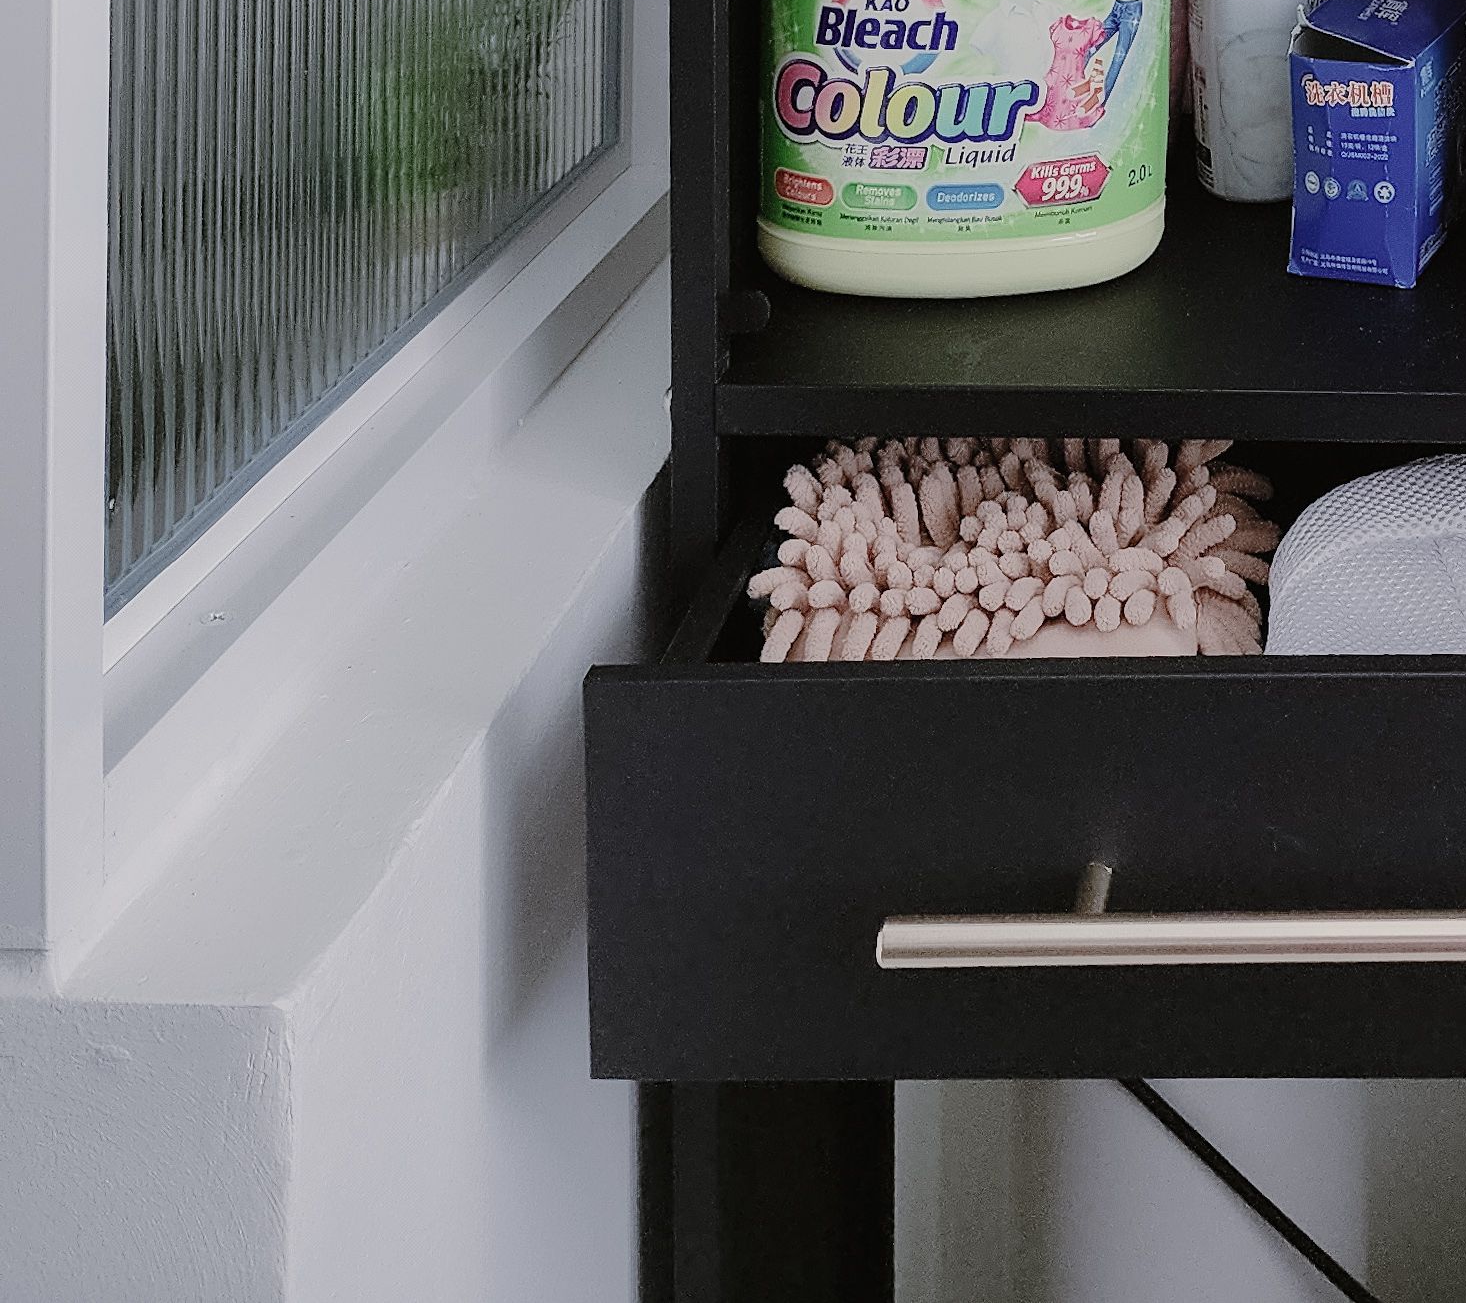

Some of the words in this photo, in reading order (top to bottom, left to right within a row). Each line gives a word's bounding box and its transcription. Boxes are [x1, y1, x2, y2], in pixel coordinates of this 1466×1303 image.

[816, 5, 959, 51] Bleach
[774, 58, 1040, 143] Colour
[1305, 80, 1395, 108] 洗衣机槽
[844, 143, 869, 155] 花王
[868, 144, 929, 170] 彩漂
[945, 143, 1017, 169] Liquid
[841, 156, 866, 168] 液体
[1031, 163, 1060, 180] Kills
[1060, 161, 1097, 176] Germs
[855, 184, 902, 197] Removes
[936, 191, 996, 203] Deodorizes
[1041, 173, 1090, 202] 99.9%
[864, 194, 896, 207] Stains
